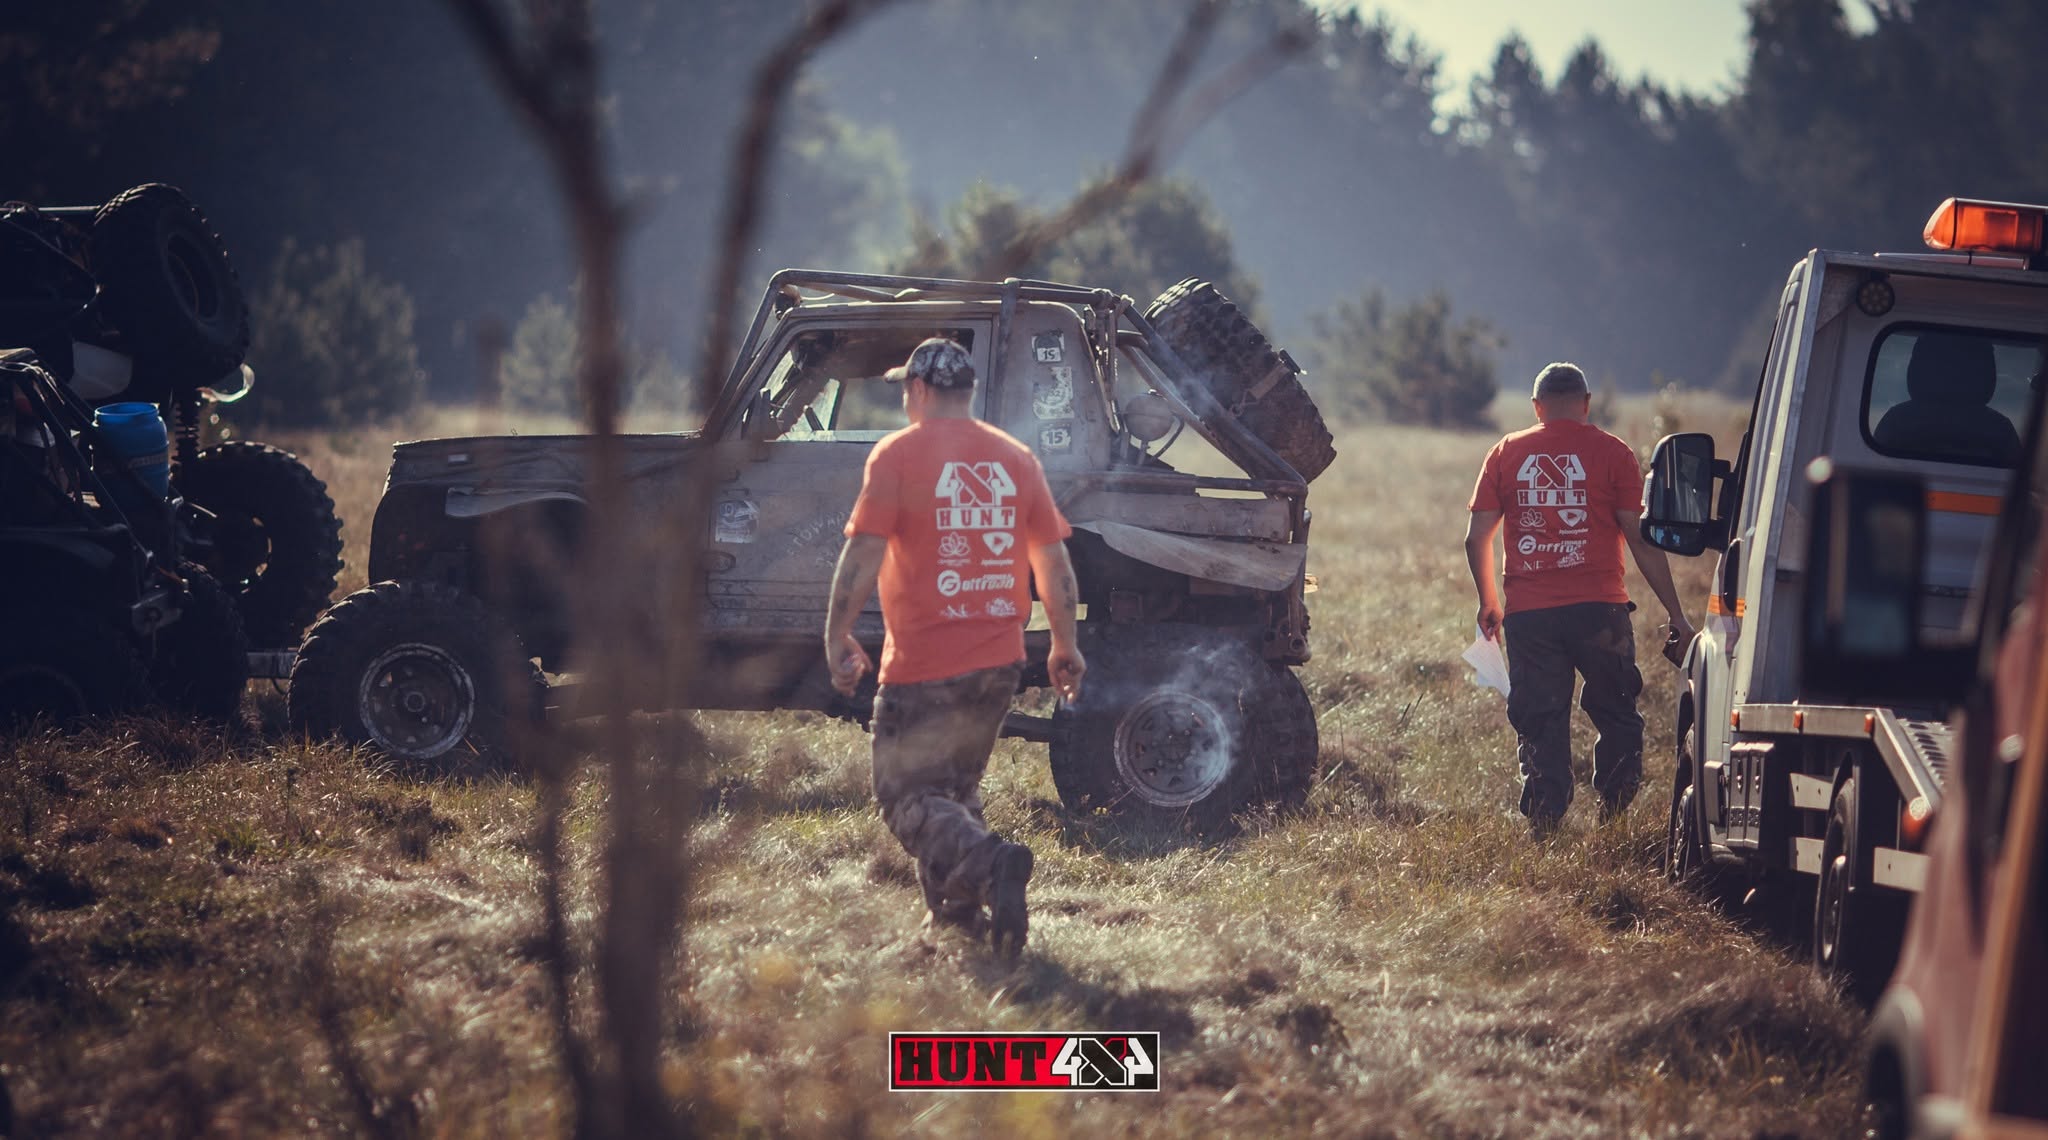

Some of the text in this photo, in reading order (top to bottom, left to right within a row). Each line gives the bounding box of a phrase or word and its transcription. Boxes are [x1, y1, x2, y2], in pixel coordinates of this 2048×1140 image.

[1043, 349, 1055, 360] 15
[1046, 431, 1063, 445] 15
[1519, 491, 1585, 504] HUNT
[939, 509, 1013, 527] HUNT
